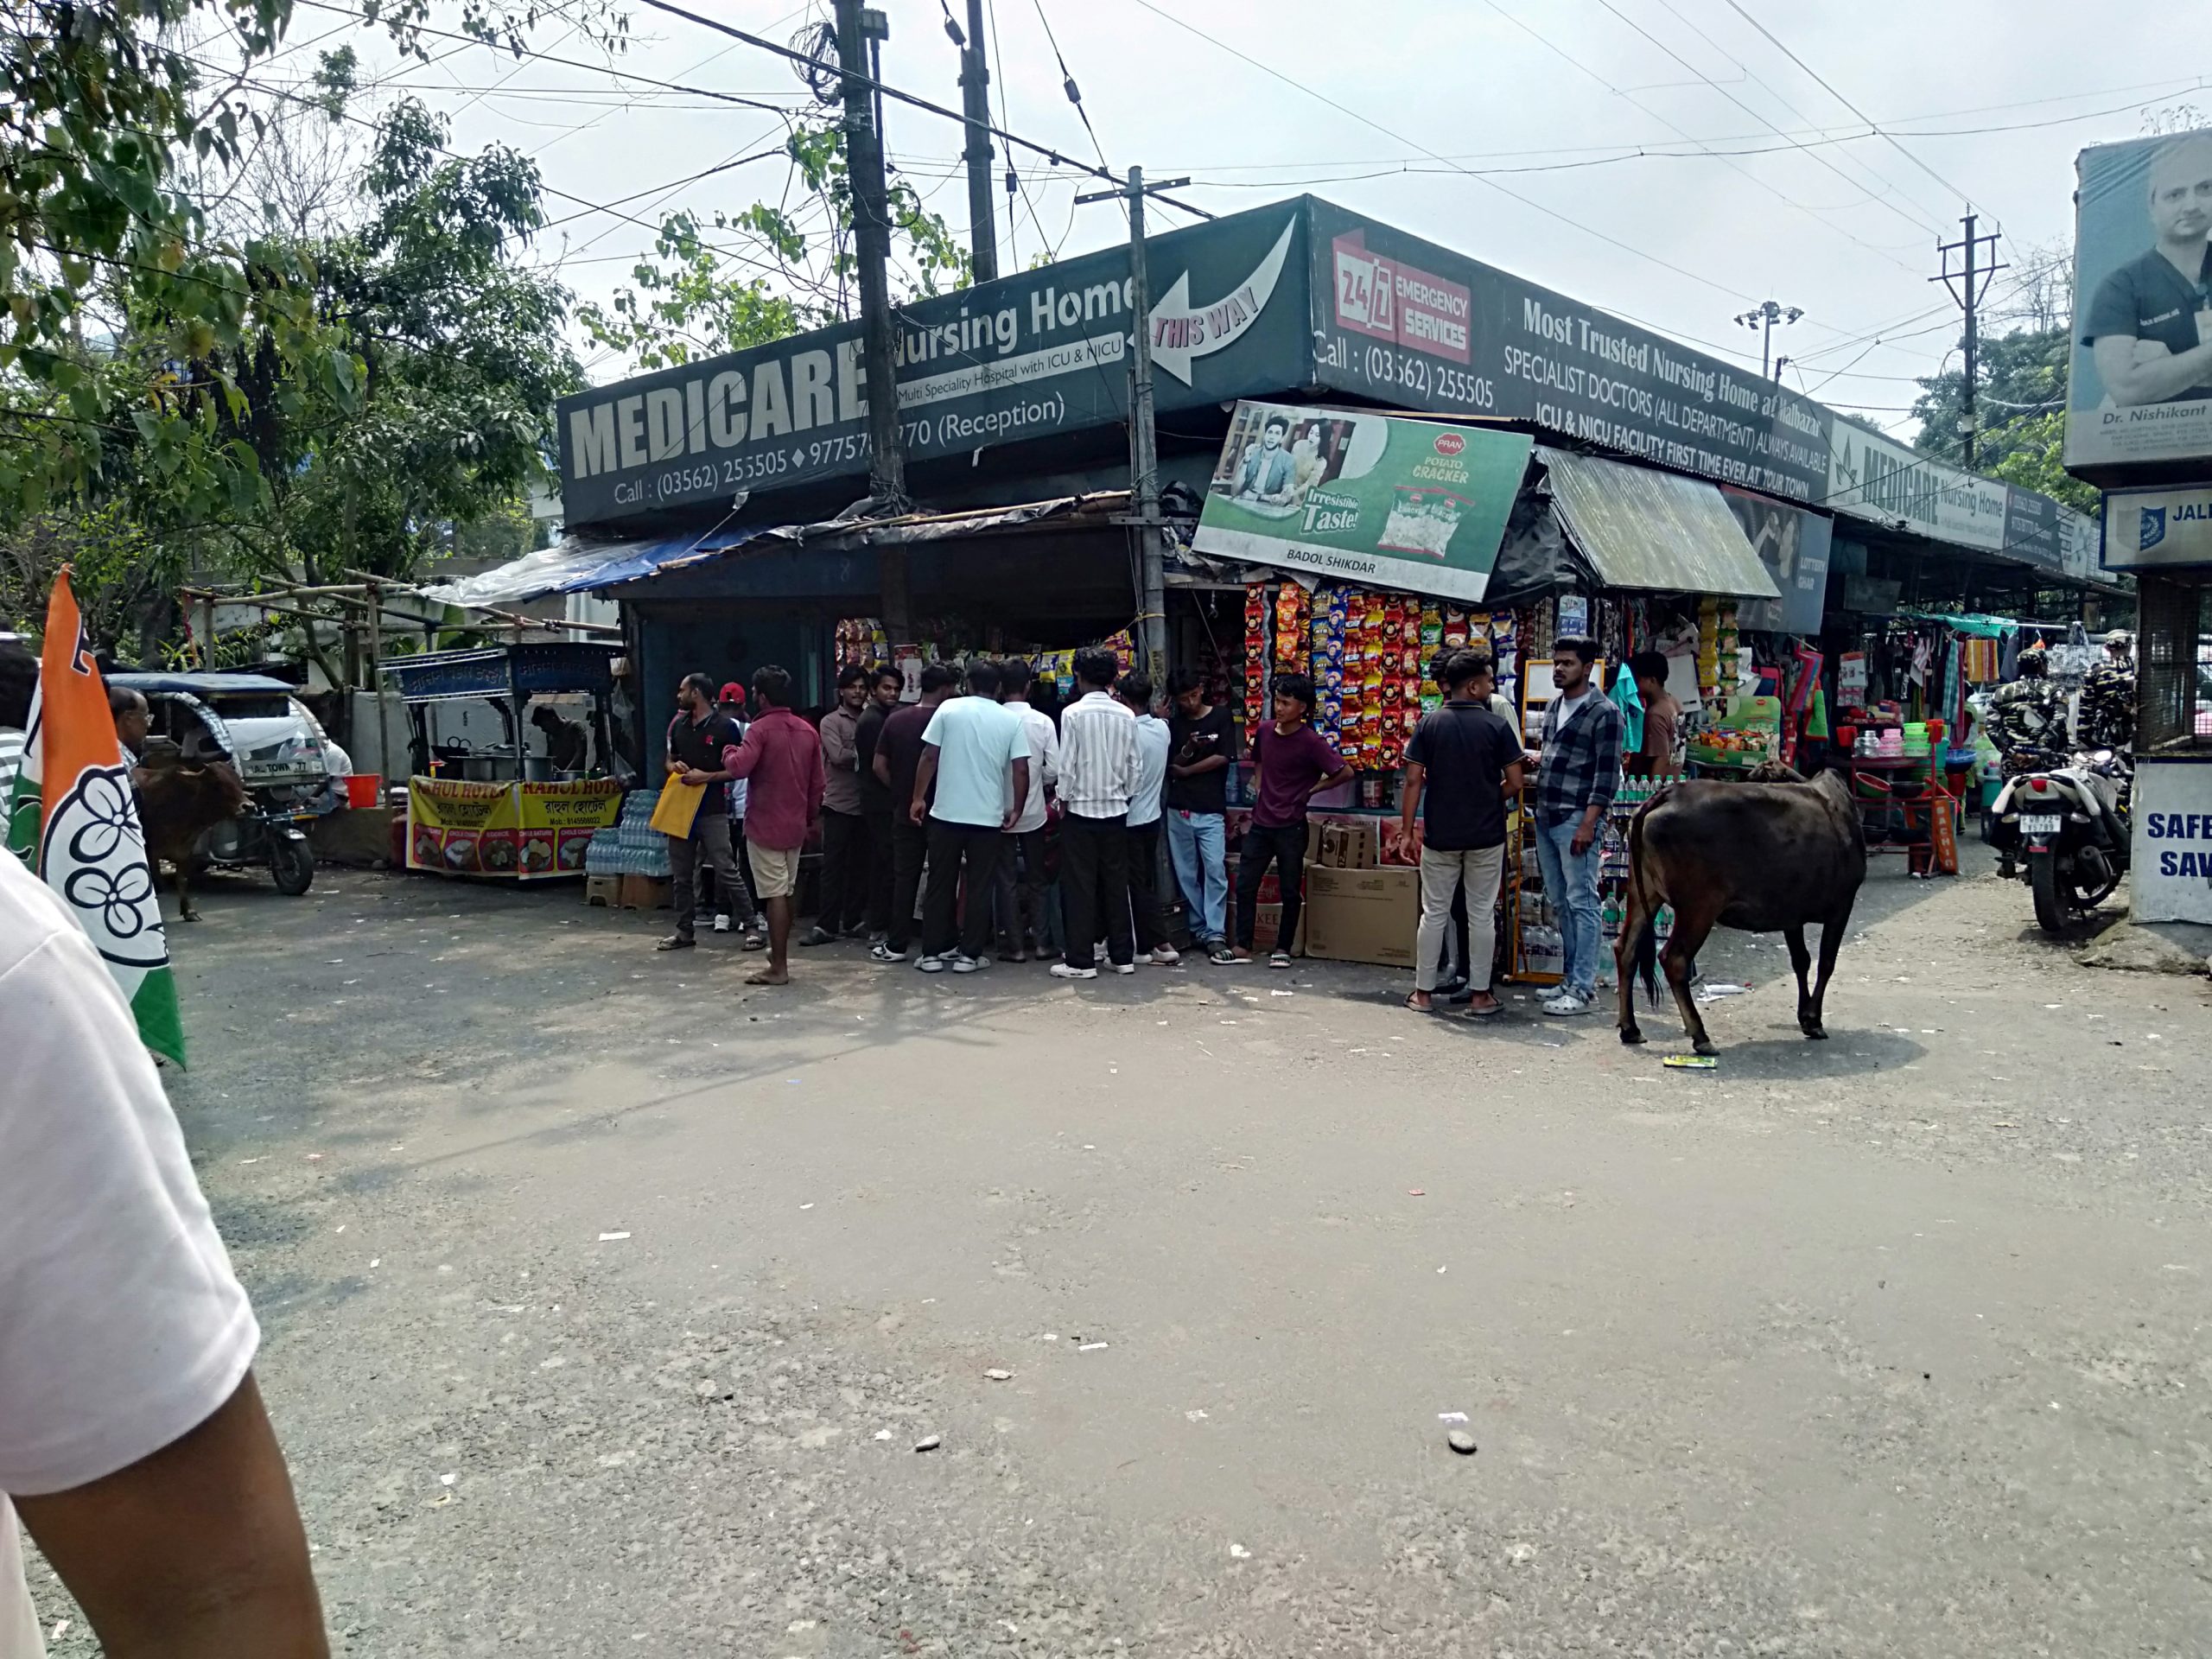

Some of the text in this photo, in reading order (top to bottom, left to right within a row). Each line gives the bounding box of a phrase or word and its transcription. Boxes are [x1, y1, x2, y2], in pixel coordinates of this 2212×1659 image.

[1154, 286, 1259, 349] THIS WAY
[1396, 276, 1468, 318] EMERGENCY
[1405, 308, 1466, 351] SERVICES
[899, 340, 1122, 402] Multi Speciality Hospital with ICU & NICU
[1313, 330, 1347, 370] Call
[1365, 345, 1432, 401] (03562)
[1437, 366, 1494, 409] 255505
[1523, 297, 1573, 346] Most
[1578, 318, 1648, 372] Trusted
[1653, 347, 1715, 403] Nursing
[1719, 372, 1758, 410] Home
[1762, 393, 1778, 417] at
[569, 337, 869, 480] MEDICARE
[1504, 346, 1827, 474] SPECIALIST DOCTORS (ALL DEPARTMENT) ALWAYS AVAILABLE
[2103, 405, 2208, 424] Dr. Nishikant
[614, 479, 643, 505] Call
[657, 463, 718, 502] (03562)
[724, 449, 787, 483] 255505
[938, 391, 1065, 448] (Reception)
[1424, 456, 1463, 469] POTATO
[1437, 439, 1462, 449] PRAN
[1536, 402, 1561, 432] ICU
[1565, 410, 1575, 435] &
[1579, 414, 1611, 447] NICU
[1613, 424, 1664, 456] FACILITY
[1667, 441, 1697, 467] FIRST
[1698, 451, 1722, 477] TIME
[1723, 458, 1746, 482] EVER
[1747, 465, 1761, 485] AT
[1762, 468, 1786, 493] YOUR
[1785, 476, 1809, 499] TOWN
[1412, 465, 1469, 484] CRACKER
[1862, 445, 1938, 526] MEDICARE
[1941, 479, 1976, 518] Nursing
[1979, 490, 2003, 518] Home
[1304, 504, 1358, 531] Taste!
[1307, 488, 1359, 510] Irresistible
[1286, 549, 1376, 575] BADOL SHIKDAR
[1798, 575, 1815, 590] GHAR
[1800, 556, 1827, 572] LOTTERY
[2147, 813, 2212, 839] SAFE
